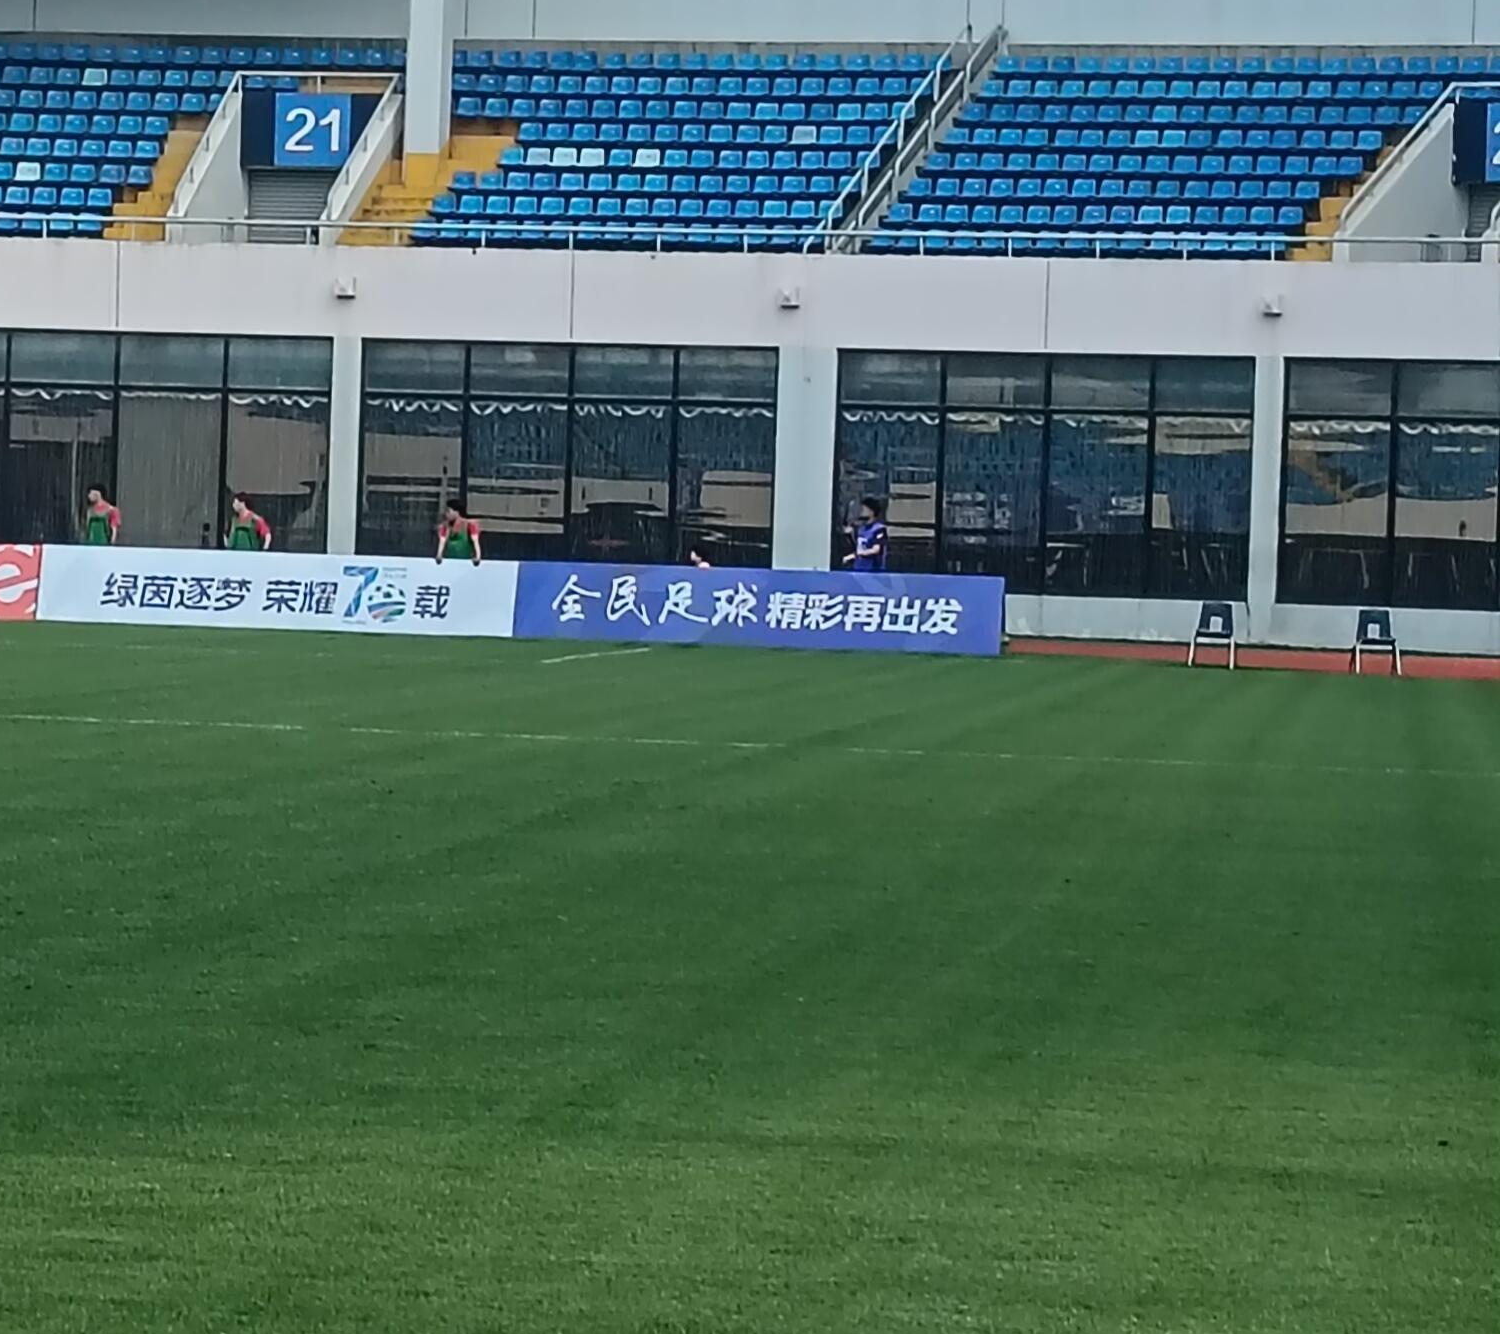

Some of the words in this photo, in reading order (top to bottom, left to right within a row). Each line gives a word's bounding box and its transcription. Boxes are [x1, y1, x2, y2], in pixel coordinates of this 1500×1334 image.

[284, 107, 341, 153] 21
[100, 572, 252, 612] 绿茵逐梦
